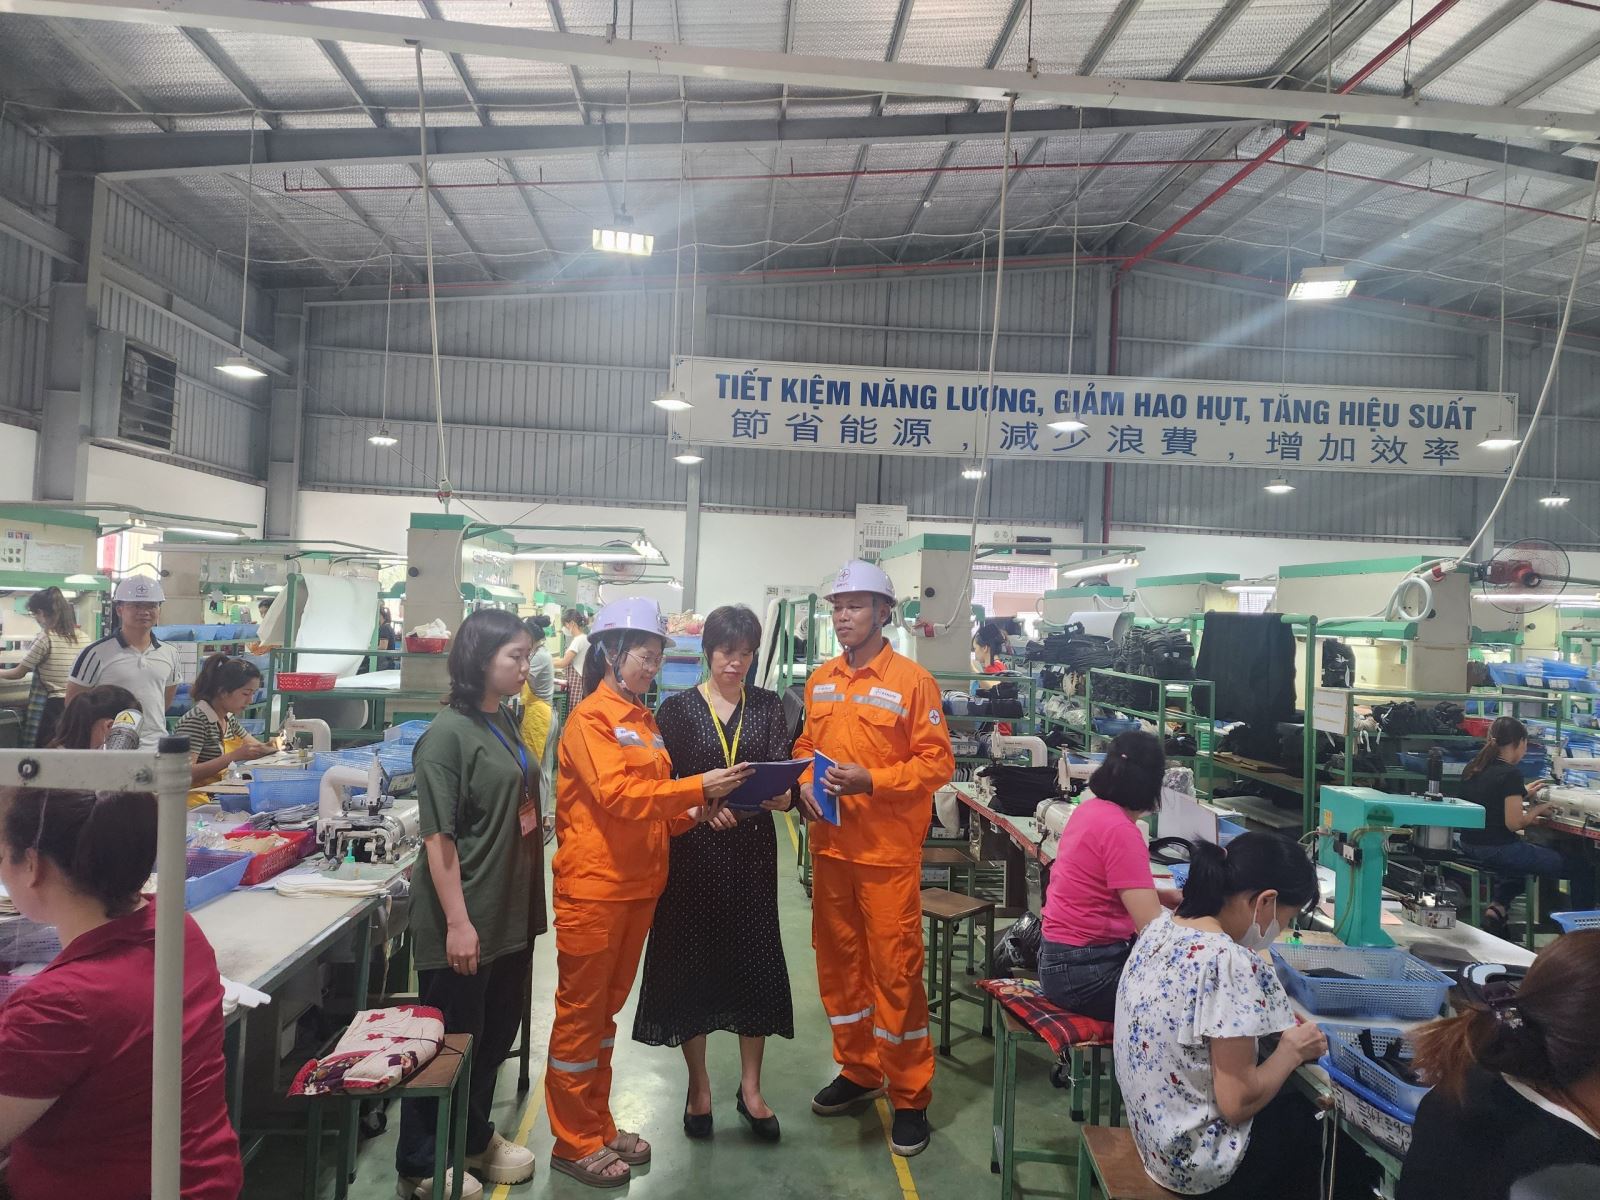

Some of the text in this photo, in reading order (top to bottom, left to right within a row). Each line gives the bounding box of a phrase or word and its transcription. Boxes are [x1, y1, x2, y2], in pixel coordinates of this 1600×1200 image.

[715, 368, 772, 401] TIẾT
[781, 374, 850, 410] KIỆM
[860, 378, 937, 410] NĂNG
[1054, 382, 1124, 416] GIẢM
[1134, 392, 1187, 419] HAO
[1196, 395, 1251, 426] HỤT,
[1260, 393, 1330, 425] TĂNG
[1339, 397, 1400, 432] HIỆU
[1408, 396, 1477, 430] SUẤT
